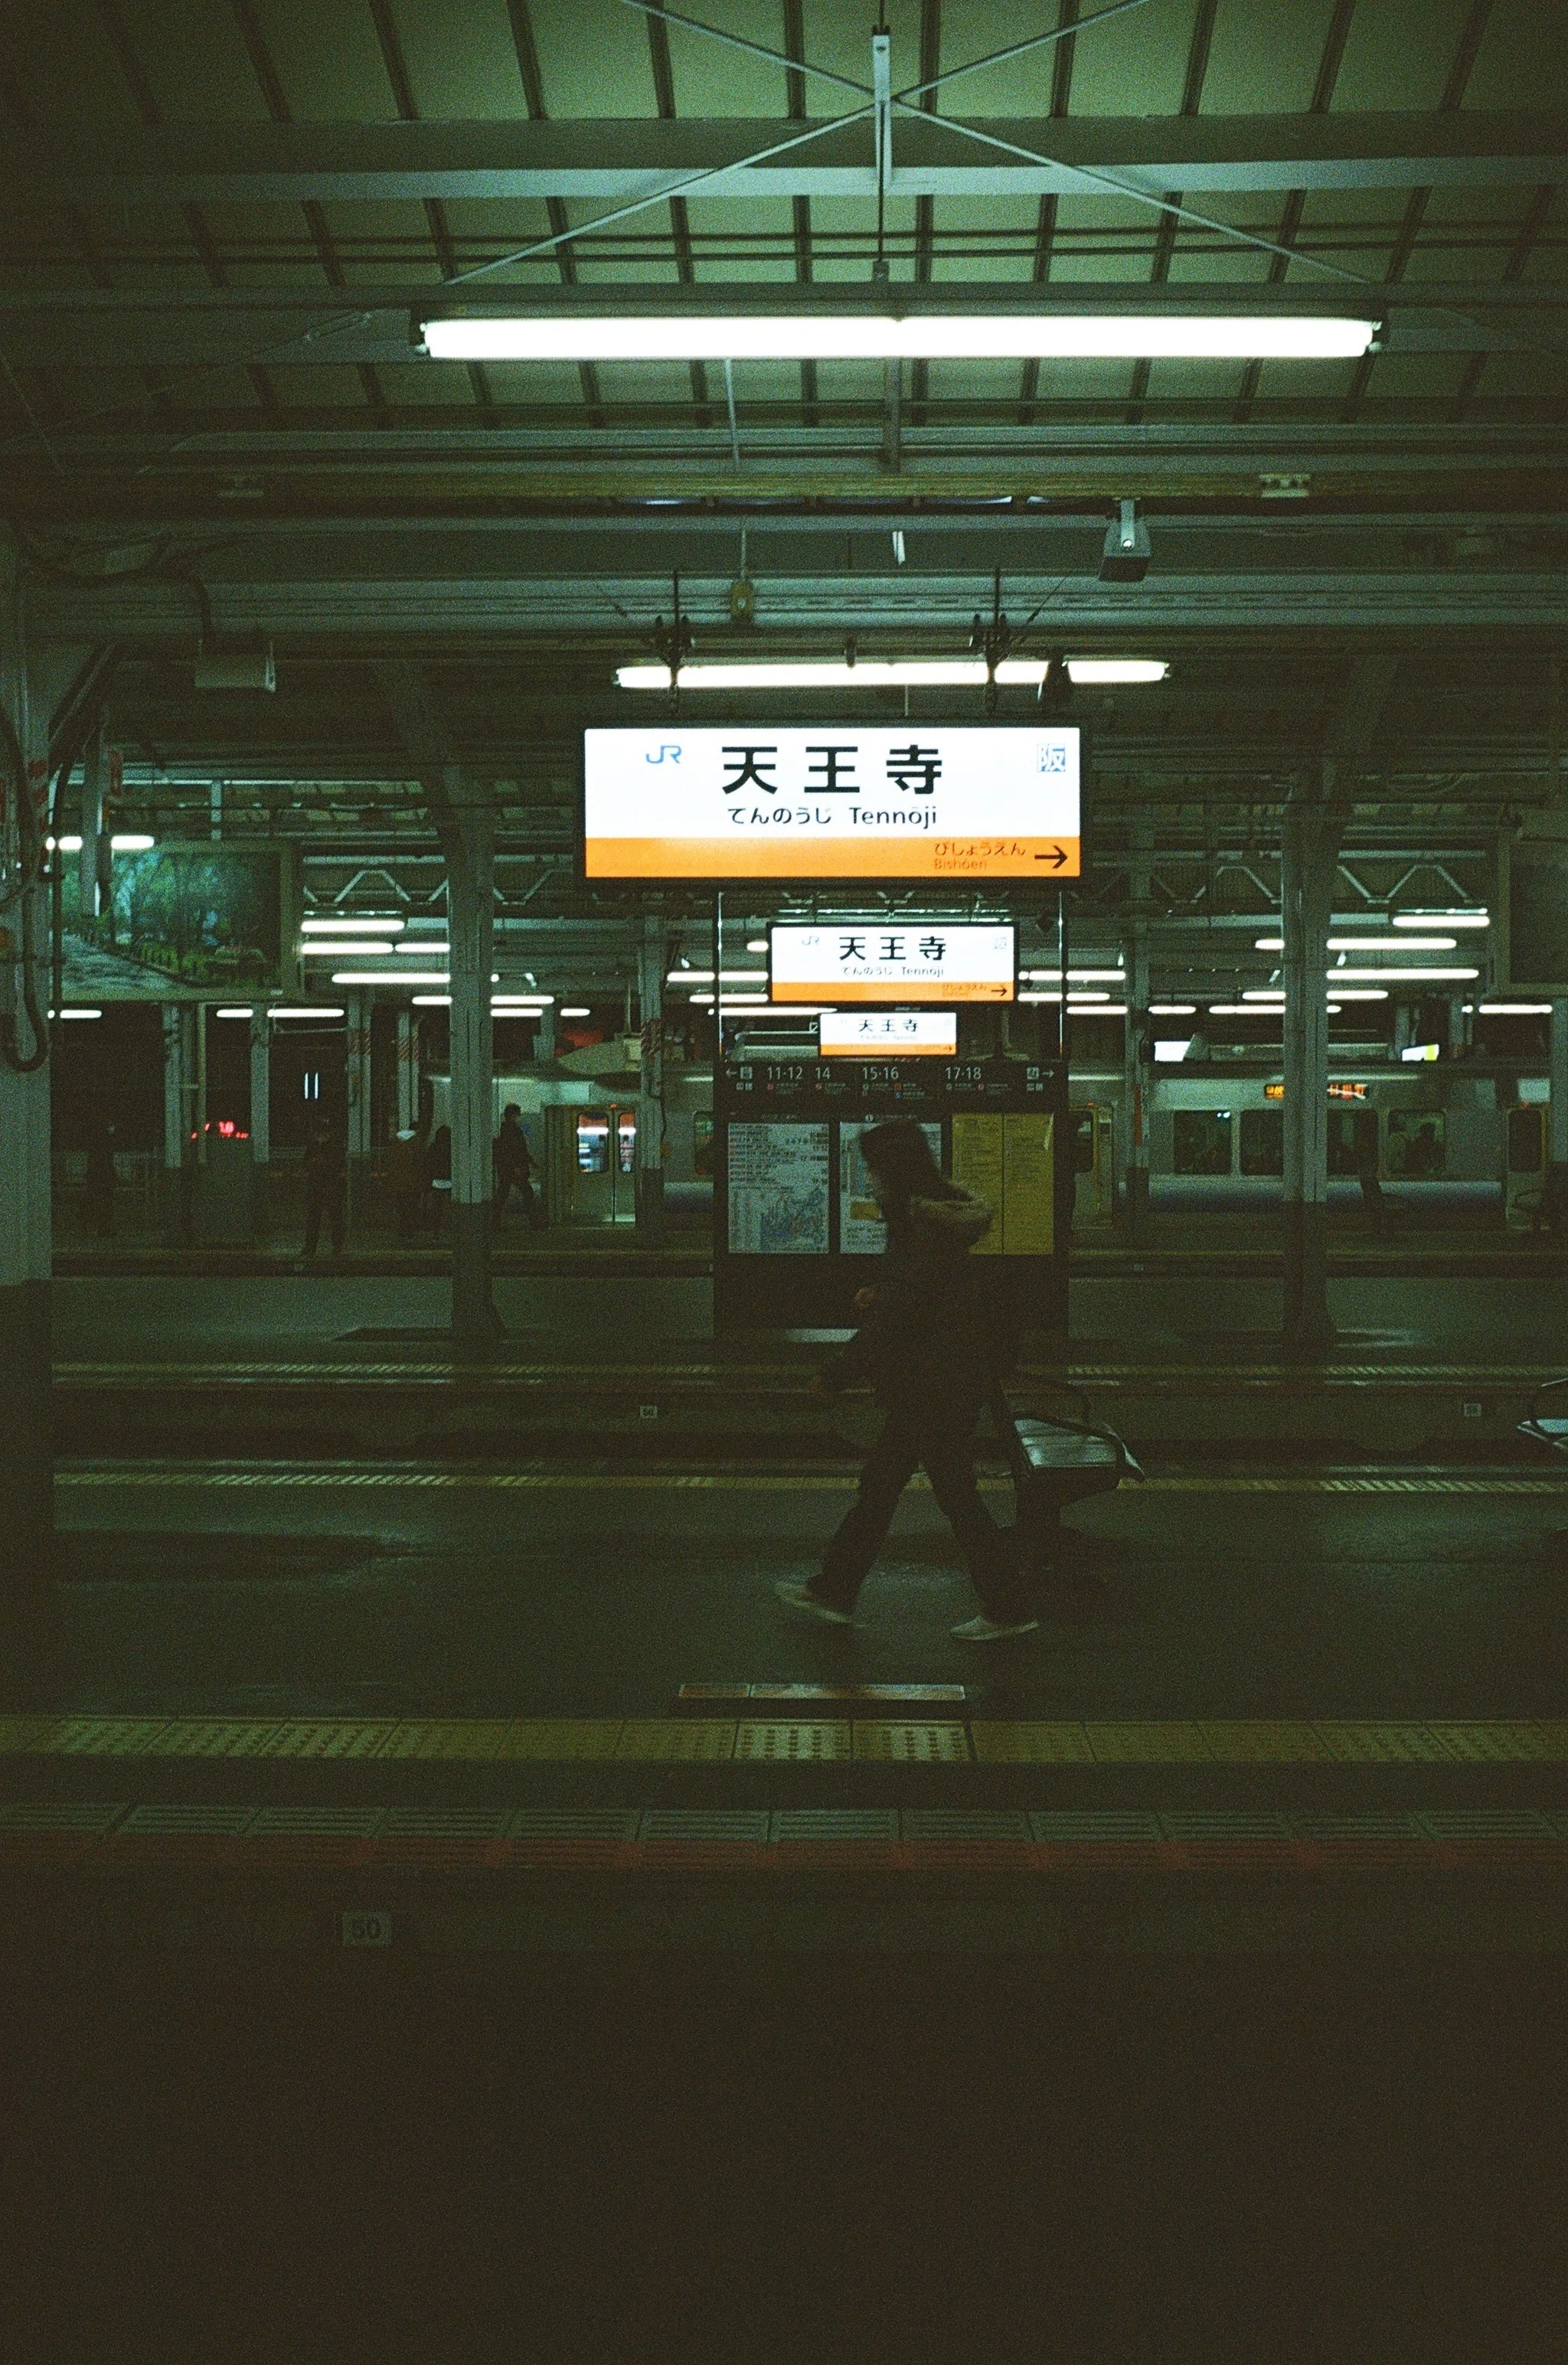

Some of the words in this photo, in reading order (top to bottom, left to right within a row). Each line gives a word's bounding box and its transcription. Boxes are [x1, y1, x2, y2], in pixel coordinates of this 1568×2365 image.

[645, 744, 683, 764] JR
[721, 744, 942, 795] 天王寺
[727, 807, 832, 825] てんのうじ
[838, 936, 946, 961] 天王寺
[858, 1018, 919, 1033] 天王寺
[815, 1066, 831, 1080] 14
[351, 1919, 381, 1939] 50
